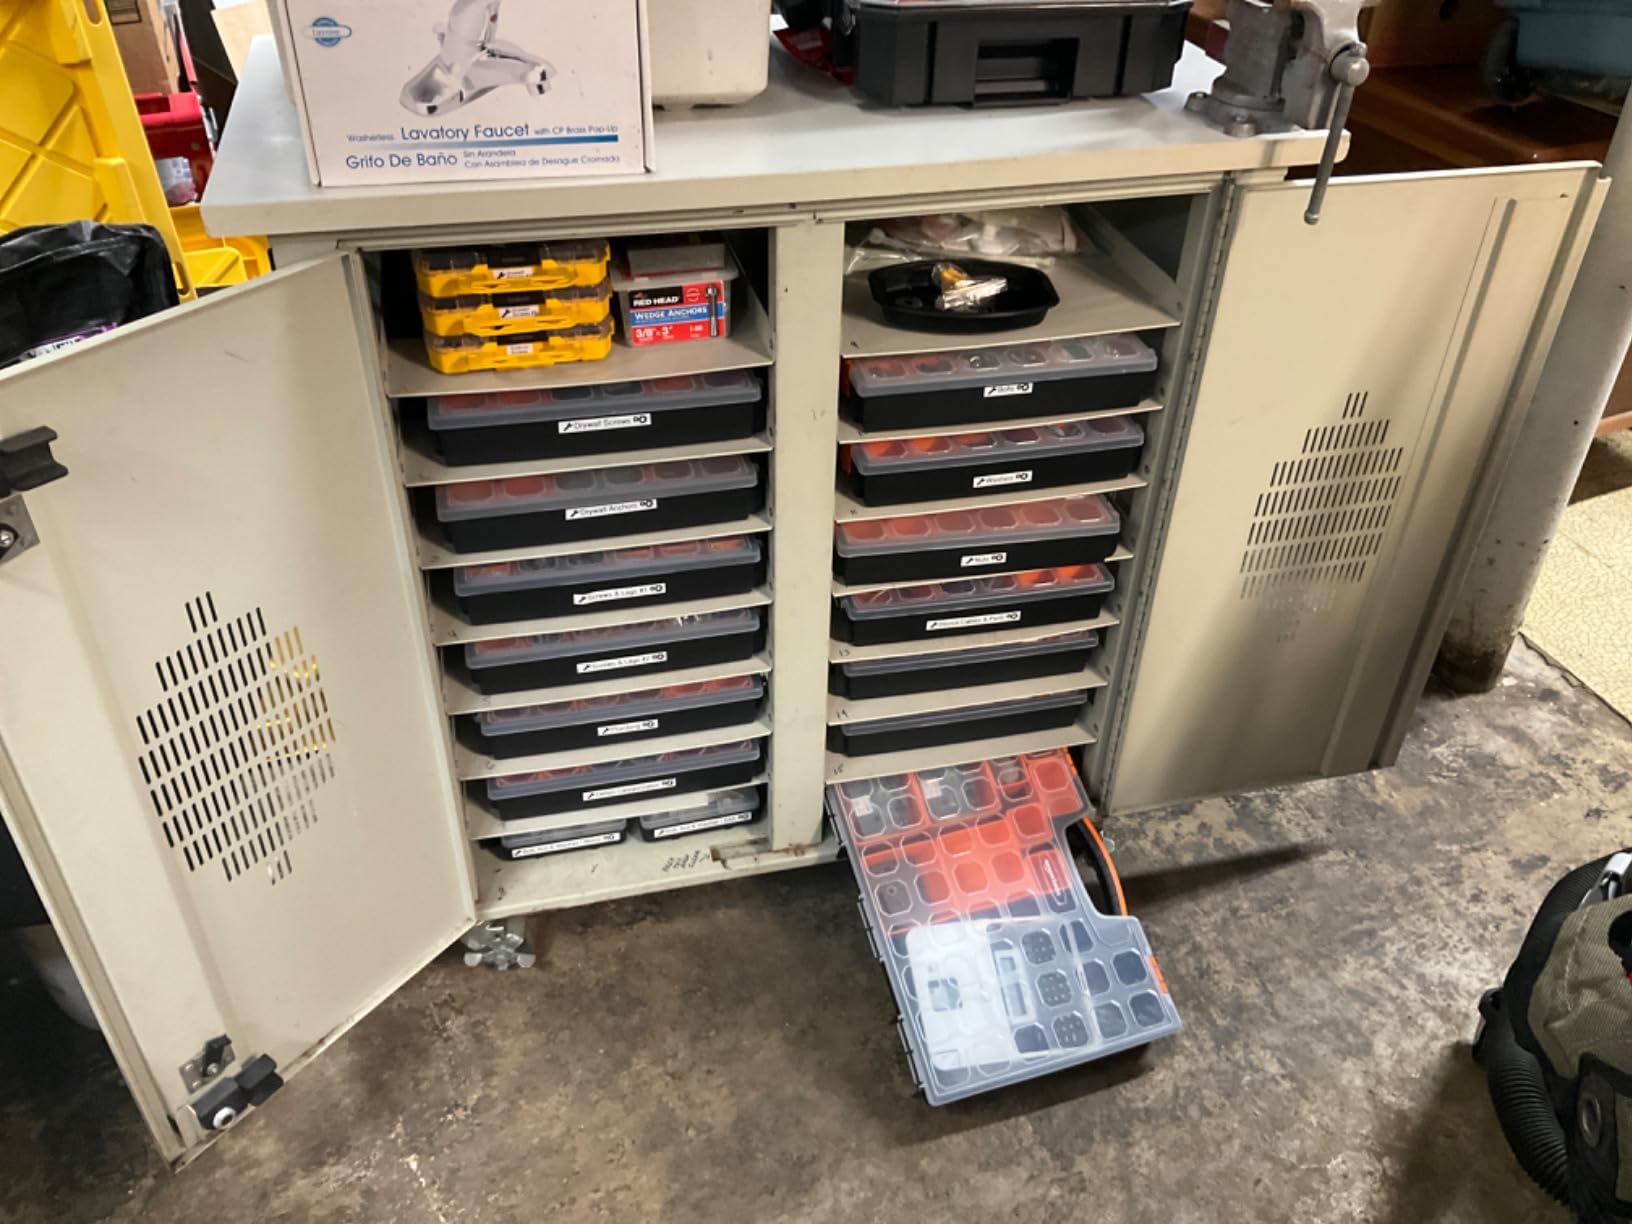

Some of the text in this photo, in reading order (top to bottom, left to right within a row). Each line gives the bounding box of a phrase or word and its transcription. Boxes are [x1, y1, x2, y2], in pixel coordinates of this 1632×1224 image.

[401, 126, 470, 142] Lavatory
[474, 123, 530, 139] Faucet
[535, 128, 550, 136] with
[552, 127, 564, 135] CP
[588, 125, 618, 135] Pop-Up
[345, 151, 458, 170] Grifo De Baño
[464, 160, 481, 168] Con
[528, 157, 540, 166] de
[633, 296, 679, 307] RED HEAD
[635, 311, 665, 321] WEDGE
[668, 306, 708, 317] ANCHORS
[574, 418, 631, 431] Drywall Screws
